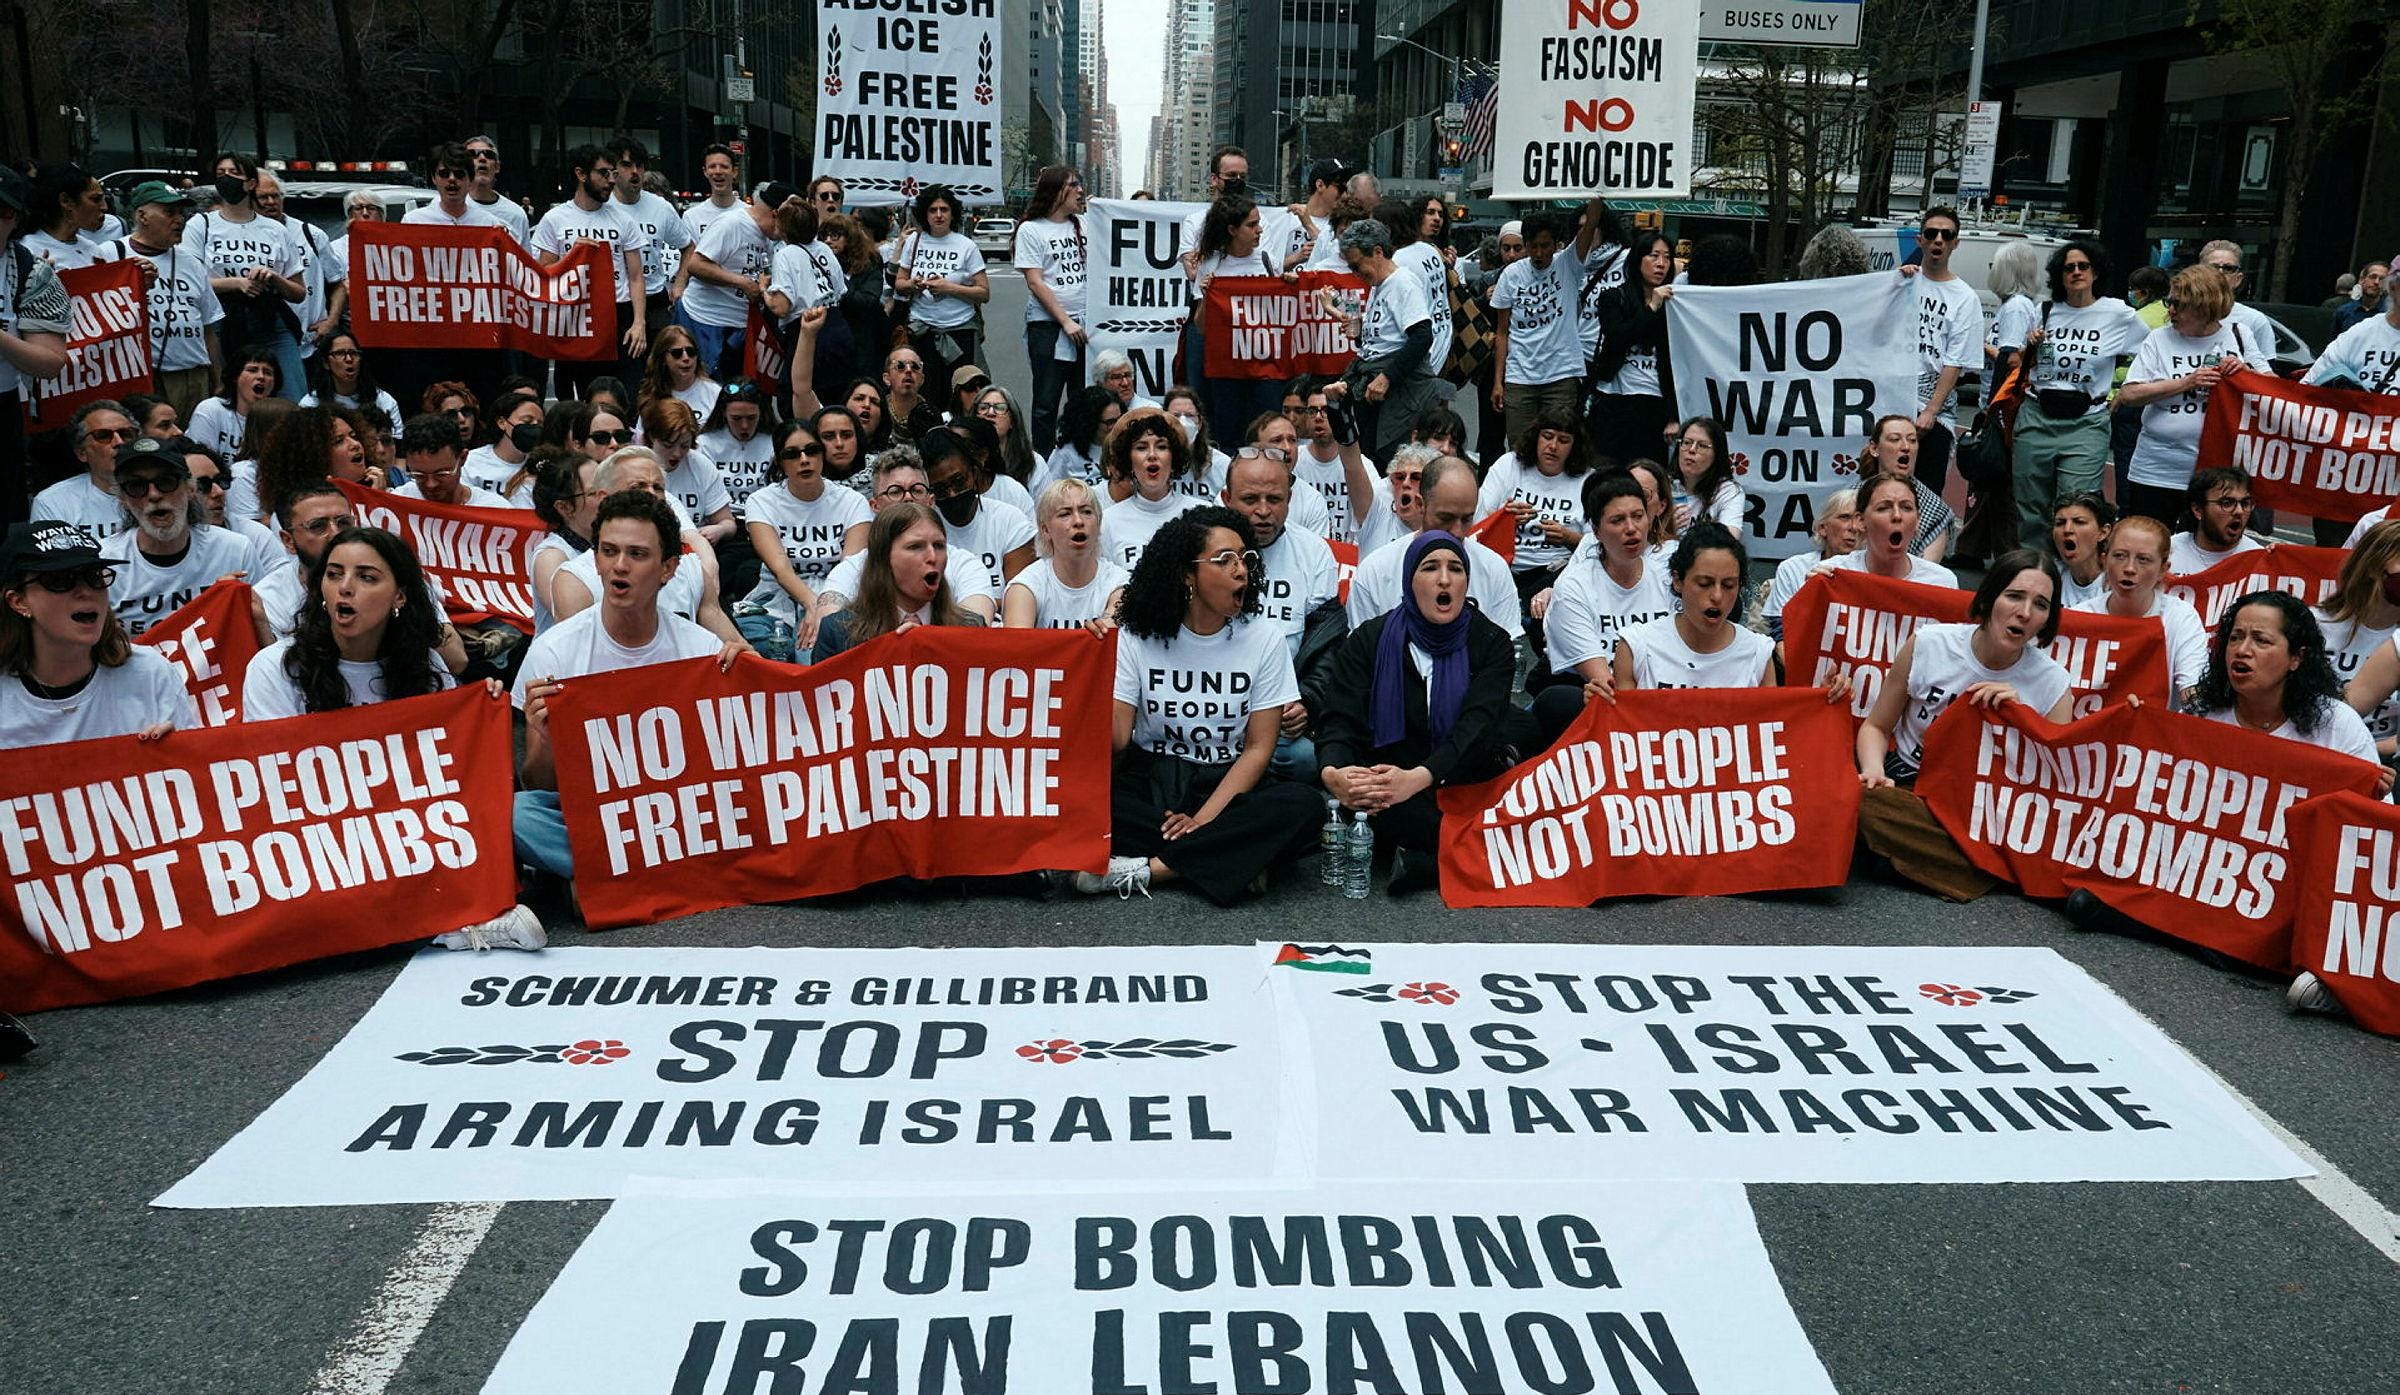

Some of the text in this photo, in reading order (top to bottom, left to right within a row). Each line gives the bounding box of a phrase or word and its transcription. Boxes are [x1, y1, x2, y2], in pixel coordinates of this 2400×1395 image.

[877, 17, 939, 53] ICE
[1568, 0, 1639, 30] NO
[1725, 10, 1839, 31] BUSES ONLY
[1541, 36, 1662, 82] FASCISM
[858, 70, 958, 110] FREE
[1564, 97, 1635, 133] NO
[823, 113, 993, 167] PALESTINE
[1522, 140, 1674, 189] GENOCIDE
[213, 239, 272, 255] FUND
[565, 228, 619, 240] FUND
[1050, 235, 1088, 251] FUND
[1110, 218, 1180, 271] FU
[213, 255, 274, 269] PEOPLE
[224, 267, 251, 280] NO
[363, 243, 414, 282] NO
[421, 246, 500, 284] WAR
[505, 252, 541, 300] NO
[548, 264, 591, 304] ICE
[916, 249, 959, 261] FUND
[146, 294, 195, 307] EOPLE
[367, 285, 594, 338] FREE PALESTINE
[1108, 277, 1192, 308] HEALT
[1231, 295, 1298, 327] FUND
[151, 326, 202, 339] OMBS
[1232, 327, 1287, 361] NOT
[1291, 323, 1361, 357] OMB
[1739, 310, 1841, 372] NO
[2048, 326, 2101, 342] UND
[2056, 343, 2100, 356] OPLE
[2058, 357, 2087, 370] OT
[1704, 377, 1877, 438] WAR
[2239, 393, 2339, 444] FUND
[1761, 448, 1819, 482] ON
[2233, 433, 2313, 484] NOT
[1173, 482, 1210, 497] ND
[1513, 487, 1574, 512] FUND
[409, 513, 516, 576] WAR
[1259, 580, 1291, 599] ND
[1149, 668, 1252, 695] FUND
[583, 663, 1065, 794] NO WAR NO ICE
[1147, 699, 1250, 720] PEOPLE
[1164, 724, 1237, 744] NOT
[1609, 721, 1790, 791] PEOPLE
[1976, 720, 2108, 800] FUND
[0, 726, 461, 877] FUND PEOPLE
[598, 746, 1060, 877] FREE PALESTINE
[1482, 784, 1797, 890] NOT BOMBS
[1968, 781, 2288, 920] NOT BOMBS
[14, 799, 478, 955] NOT BOMBS
[2333, 822, 2400, 902] FU
[461, 974, 1209, 1007] SCHUMER & GILLIBRAND
[1479, 972, 1914, 1015] STOP THE
[656, 1018, 988, 1083] STOP
[1379, 1020, 1550, 1075] US
[1644, 1022, 2100, 1075] ISRAEL
[343, 1095, 1233, 1153] ARMING ISRAEL
[1390, 1085, 2174, 1135] WAR MACHINE
[738, 1213, 1623, 1298] STOP BOMBING
[671, 1308, 1700, 1395] IRAN LEBANON
